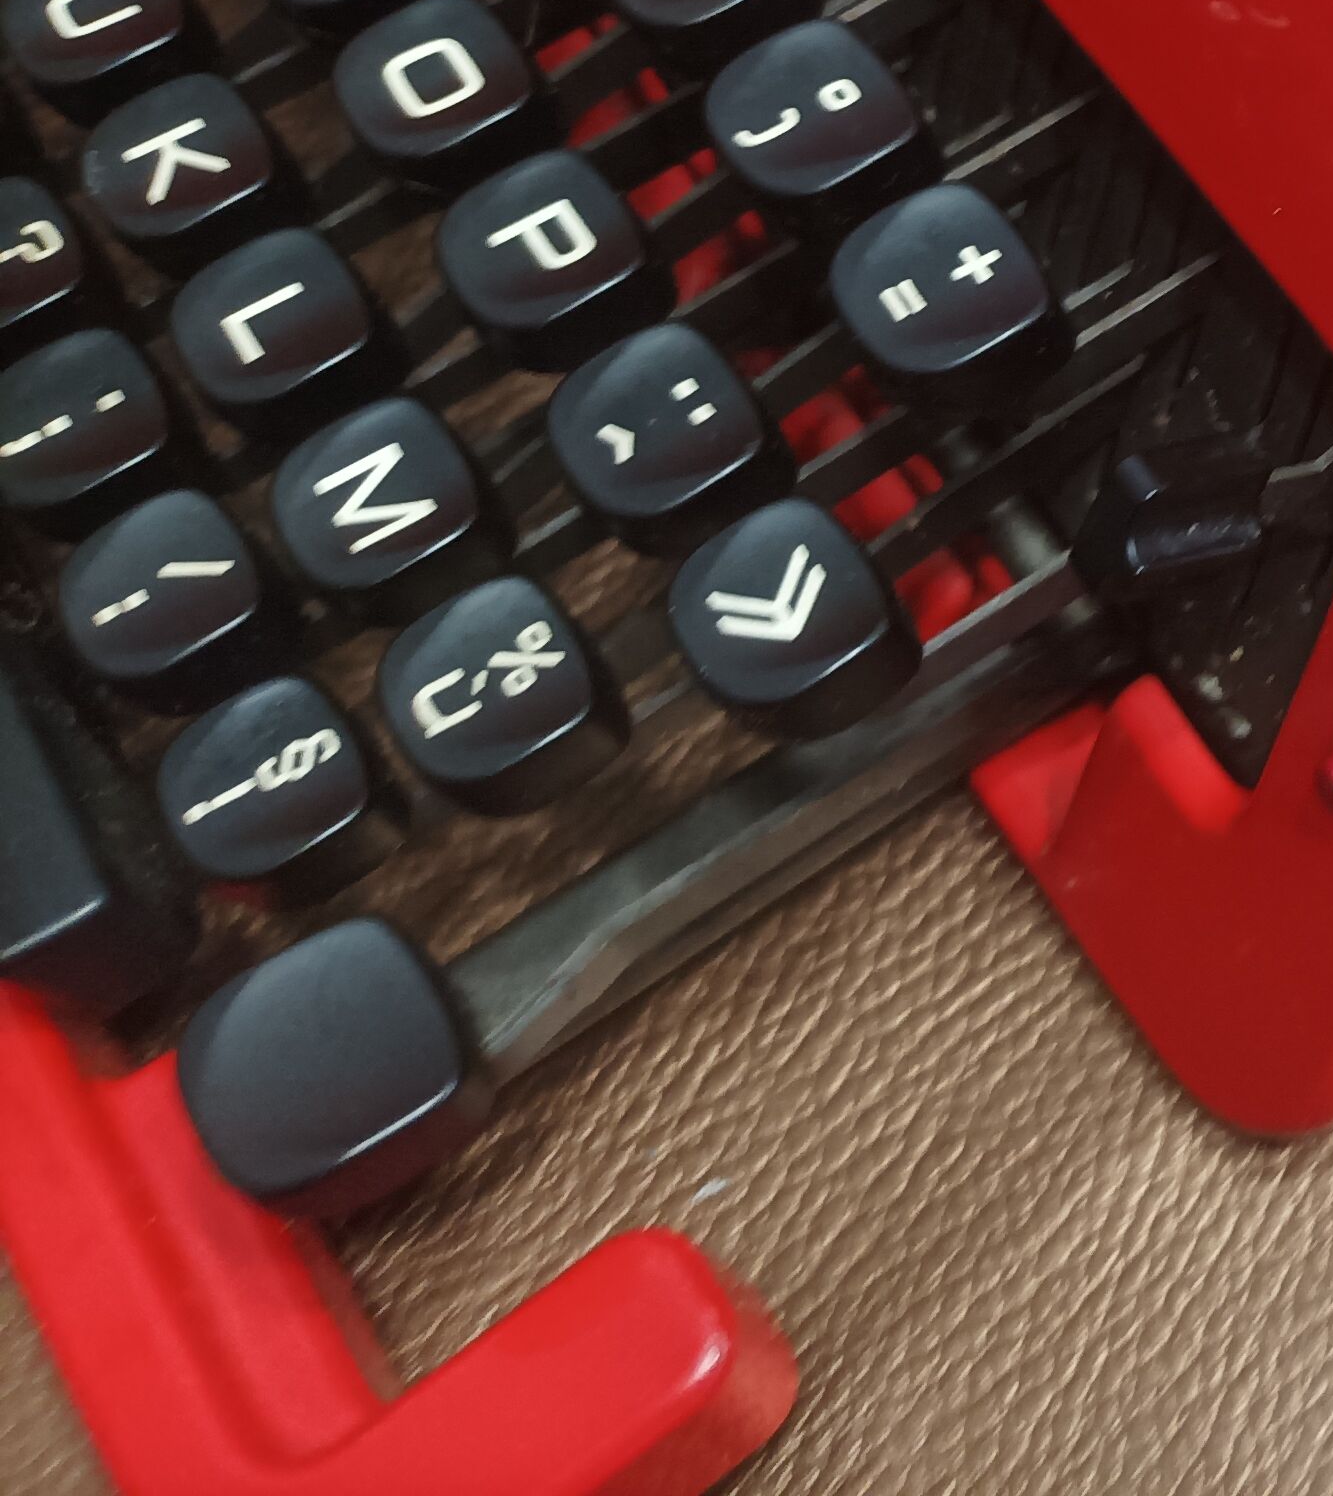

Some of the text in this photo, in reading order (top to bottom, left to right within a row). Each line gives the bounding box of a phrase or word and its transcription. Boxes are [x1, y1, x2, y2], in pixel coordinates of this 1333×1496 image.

[383, 38, 484, 117] O
[122, 118, 231, 204] K
[488, 199, 596, 269] P
[951, 246, 1001, 283] +
[221, 283, 303, 363] L
[879, 278, 927, 322] =
[313, 443, 438, 554] M
[487, 621, 565, 697] %
